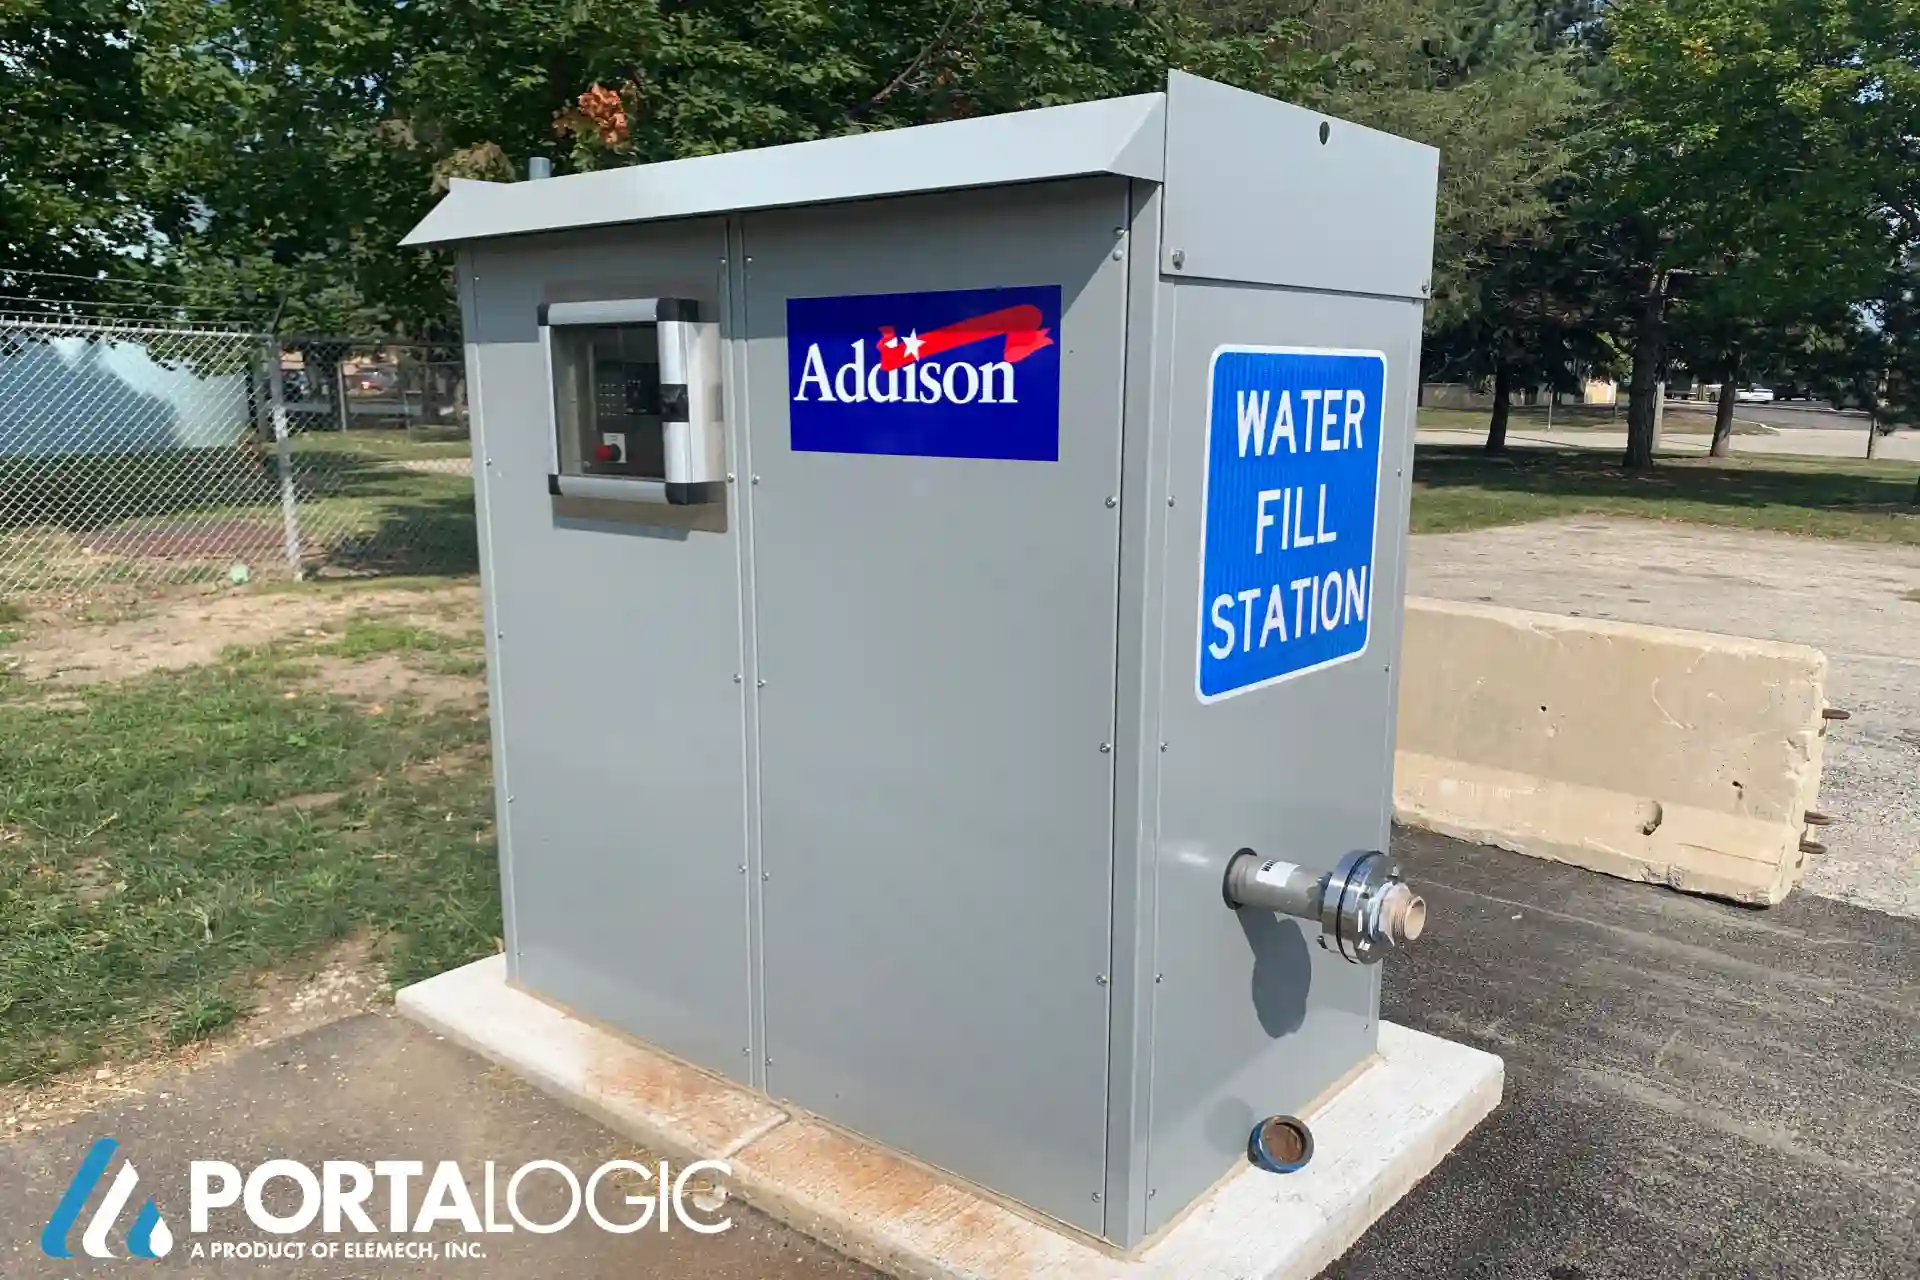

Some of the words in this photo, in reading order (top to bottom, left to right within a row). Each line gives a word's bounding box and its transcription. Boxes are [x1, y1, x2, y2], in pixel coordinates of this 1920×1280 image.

[793, 337, 1019, 404] Addison
[1236, 388, 1366, 458] WATER
[1254, 483, 1338, 555] FILL
[1207, 565, 1369, 661] STATION
